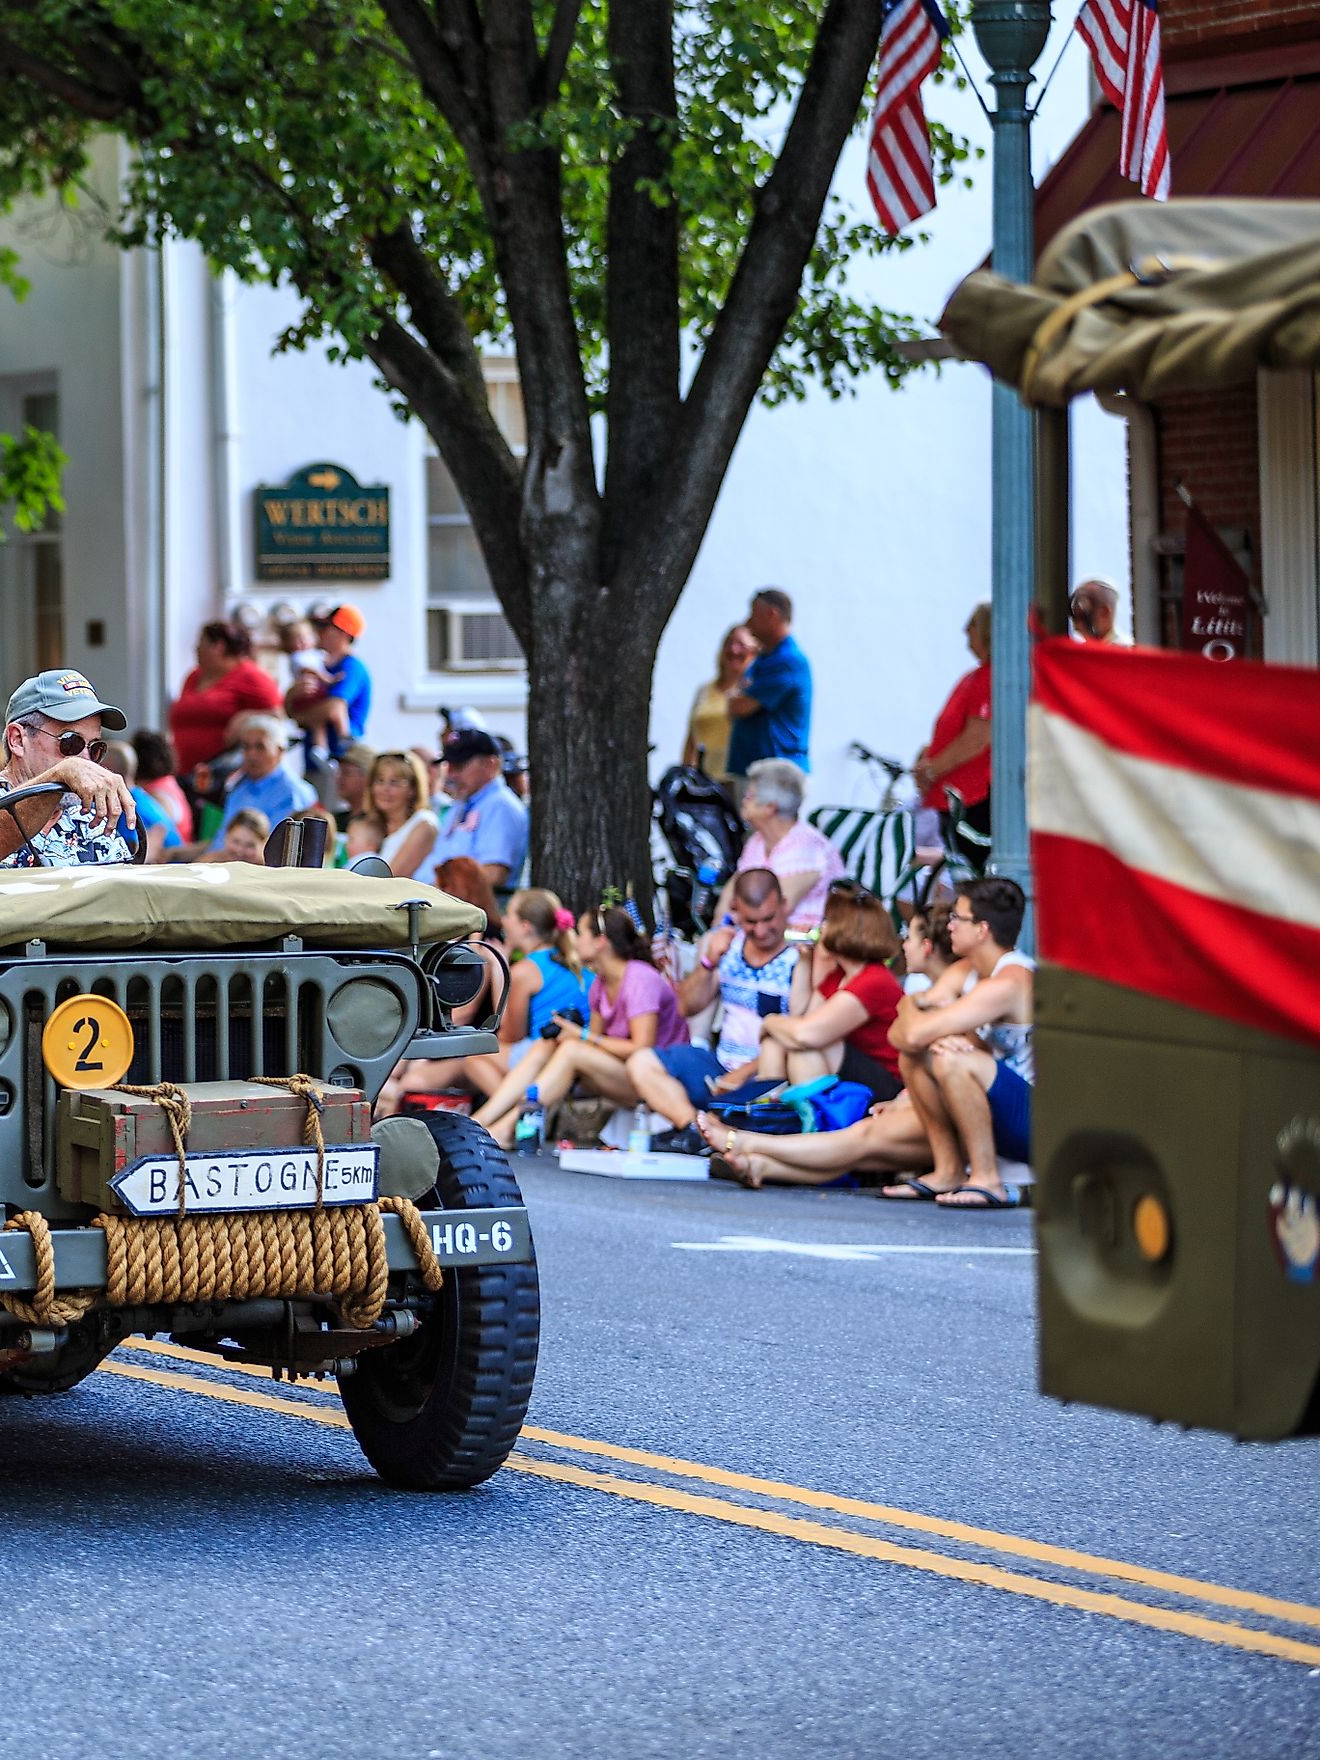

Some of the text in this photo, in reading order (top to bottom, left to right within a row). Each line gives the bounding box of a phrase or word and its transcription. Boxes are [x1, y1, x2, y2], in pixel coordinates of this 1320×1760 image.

[72, 1016, 104, 1072] 2
[149, 1159, 340, 1204] BASTOGNE
[432, 1220, 512, 1255] HQ-6
